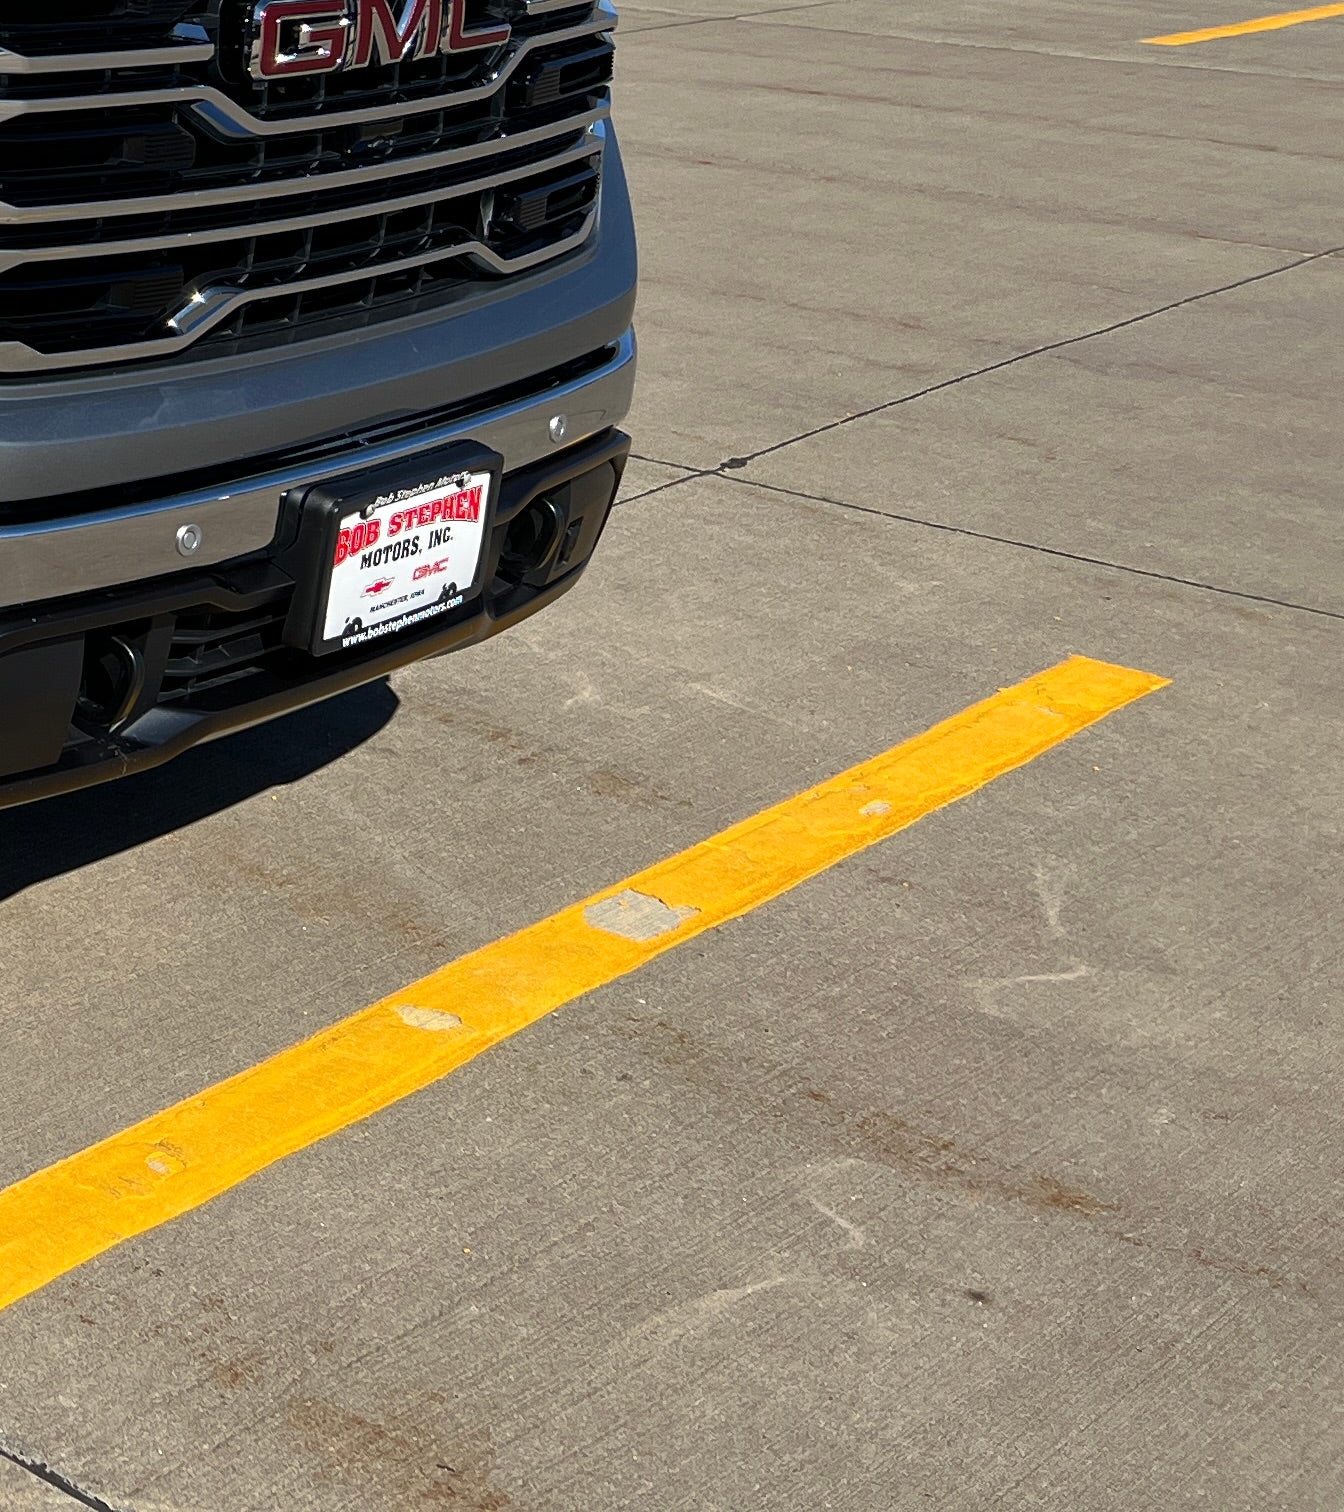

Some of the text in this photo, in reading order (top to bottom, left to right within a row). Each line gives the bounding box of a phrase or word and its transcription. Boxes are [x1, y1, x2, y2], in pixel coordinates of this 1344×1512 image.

[395, 482, 435, 502] Stephen
[334, 485, 483, 567] BOB STEPHEN
[360, 526, 453, 570] MOTORS, INC.
[412, 557, 449, 581] GMC
[342, 594, 464, 648] www.bobstephenmotors.com
